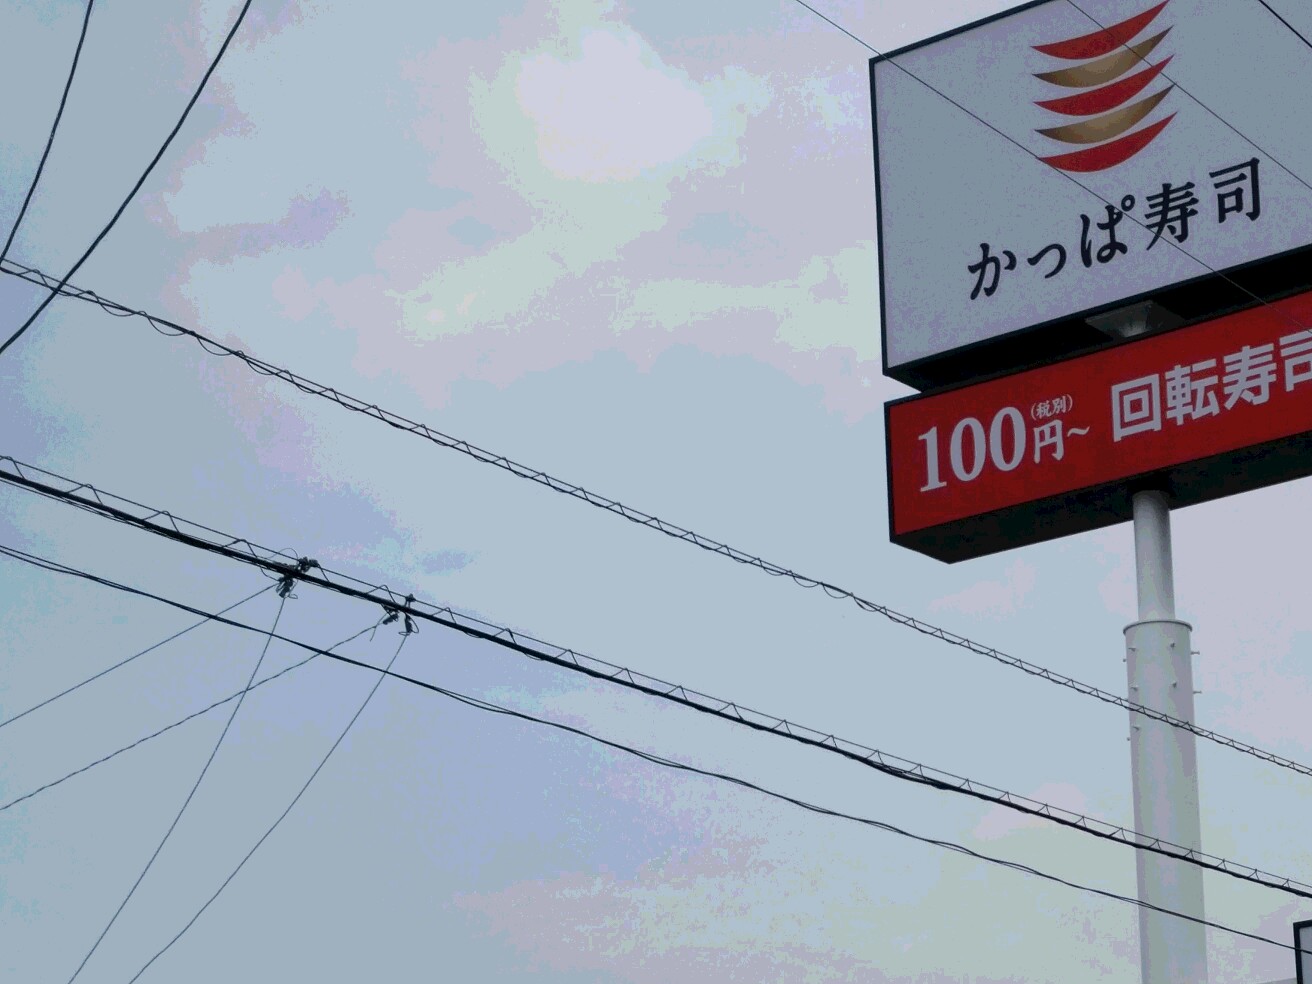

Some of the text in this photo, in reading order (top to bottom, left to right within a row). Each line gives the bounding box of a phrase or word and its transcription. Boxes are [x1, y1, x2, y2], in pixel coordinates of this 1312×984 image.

[967, 157, 1260, 300] かっぱ寿司
